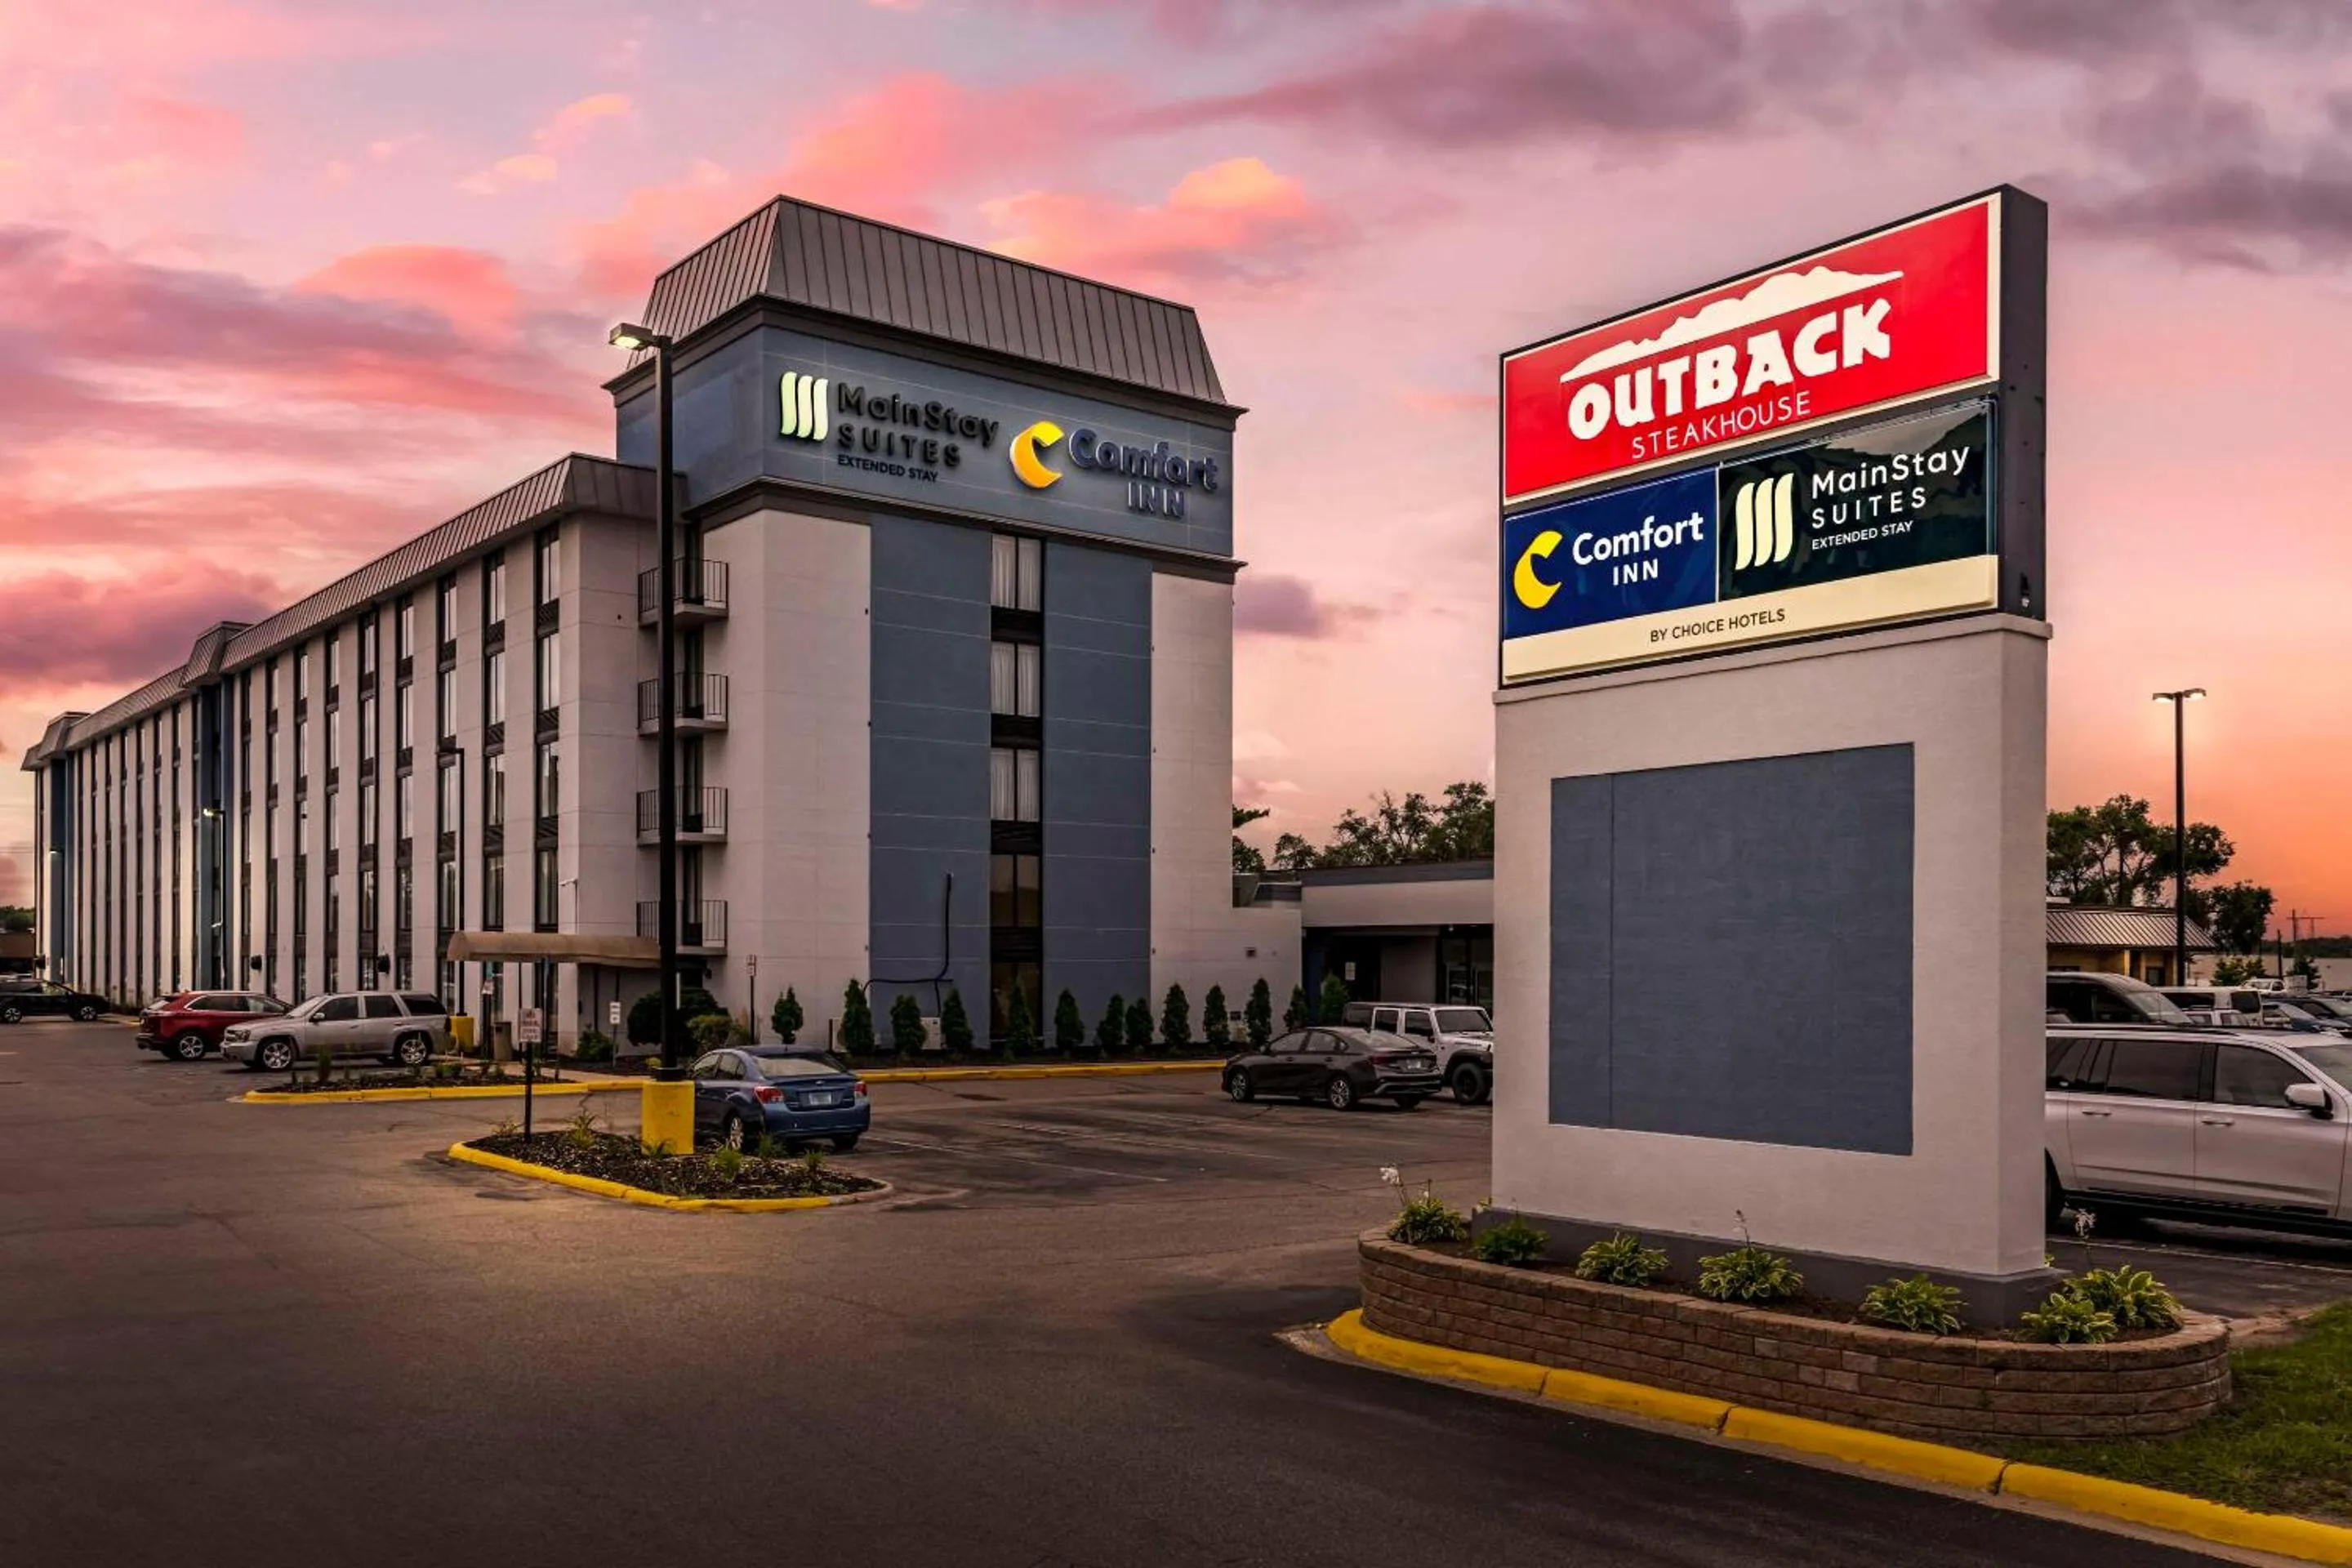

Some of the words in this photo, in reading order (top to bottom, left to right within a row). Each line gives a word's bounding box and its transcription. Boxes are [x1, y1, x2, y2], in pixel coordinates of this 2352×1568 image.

[1567, 297, 1892, 440] OUTBACK
[838, 381, 999, 448] MainStay
[1632, 390, 1811, 460] STEAKHOUSE
[837, 423, 961, 467] SUITES
[1068, 427, 1218, 490] Comfort
[837, 454, 906, 478] EXTENDED
[908, 466, 938, 483] STAY
[1811, 446, 1971, 499] MainStay
[1127, 480, 1184, 519] INN
[1811, 487, 1927, 529] SUITES
[1571, 511, 1704, 565] Comfort
[1811, 528, 1878, 550] EXTENDED
[1881, 520, 1913, 537] STAY
[1612, 558, 1659, 586] INN
[1650, 630, 1667, 643] BY
[1672, 619, 1725, 639] CHOICE
[1729, 608, 1786, 630] HOTELS
